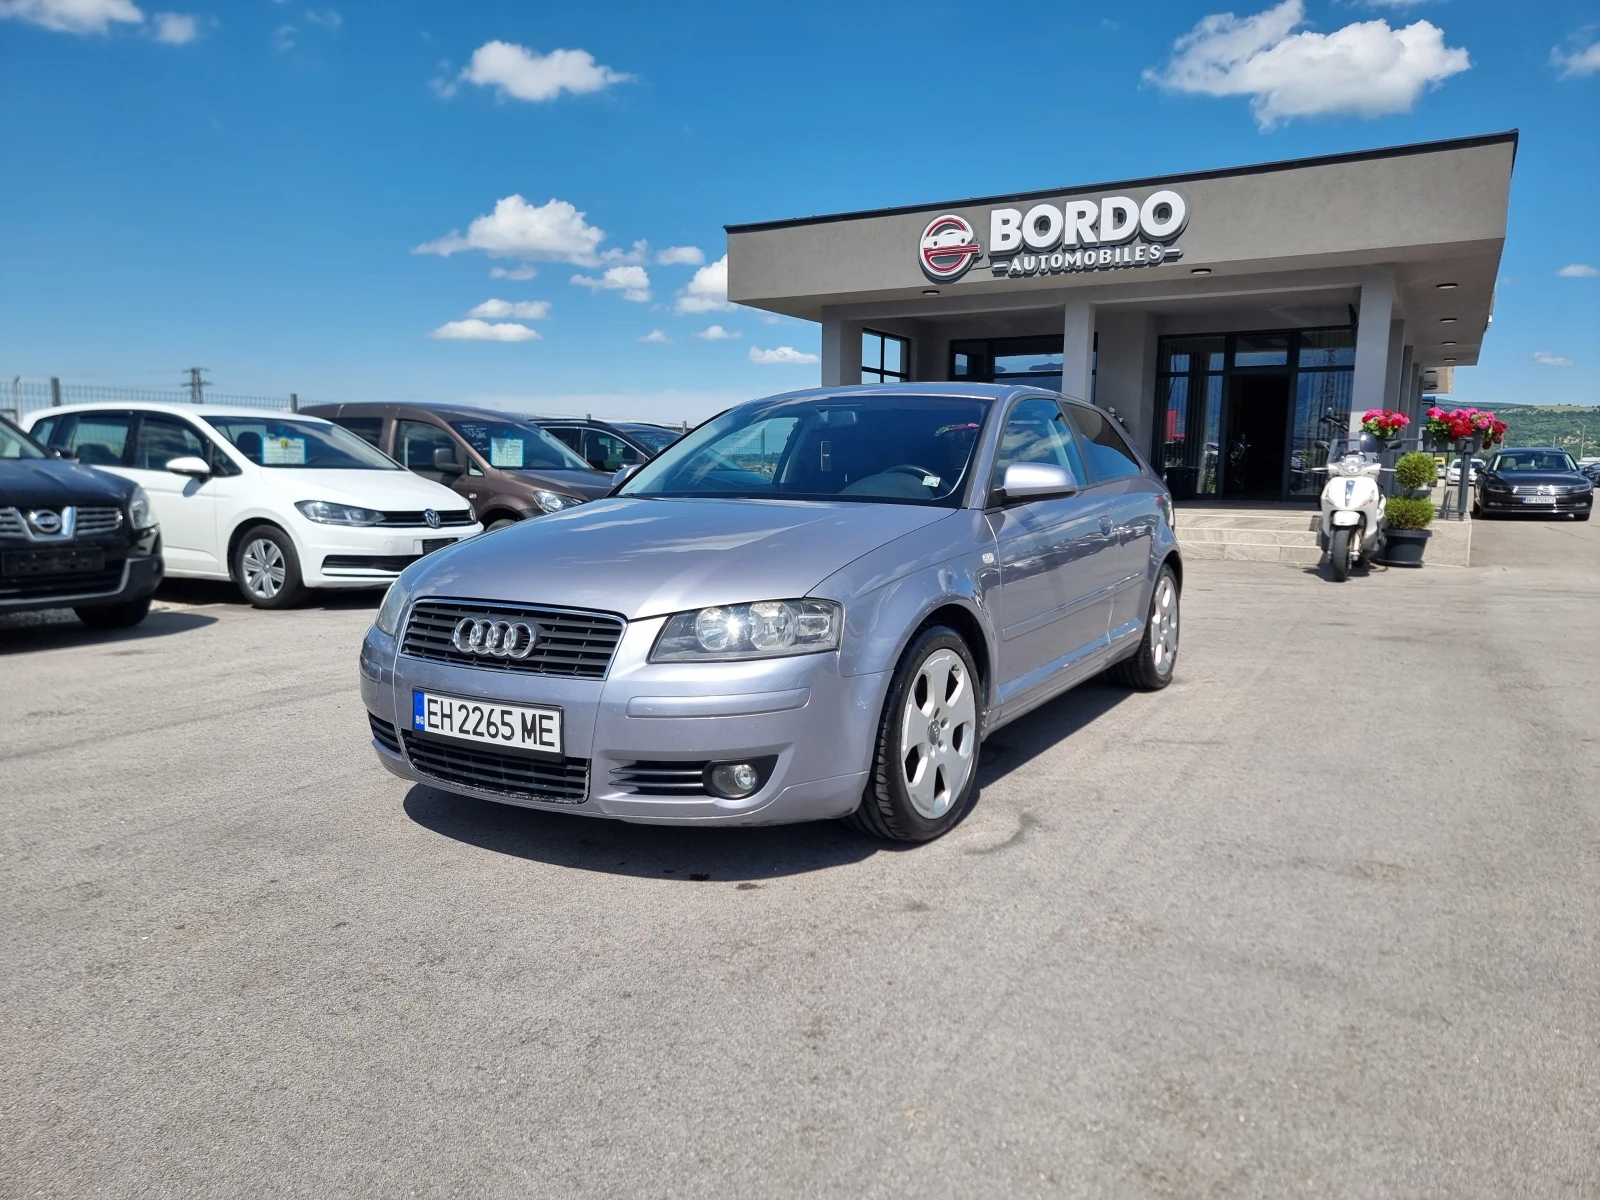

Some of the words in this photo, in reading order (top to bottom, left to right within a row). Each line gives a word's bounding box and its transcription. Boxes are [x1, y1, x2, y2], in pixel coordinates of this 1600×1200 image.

[990, 190, 1187, 254] BORDO
[1008, 244, 1161, 273] AUTOMOBILES
[415, 715, 425, 725] BG
[427, 698, 454, 732] EH
[458, 704, 515, 741] 2265
[521, 712, 556, 747] ME
